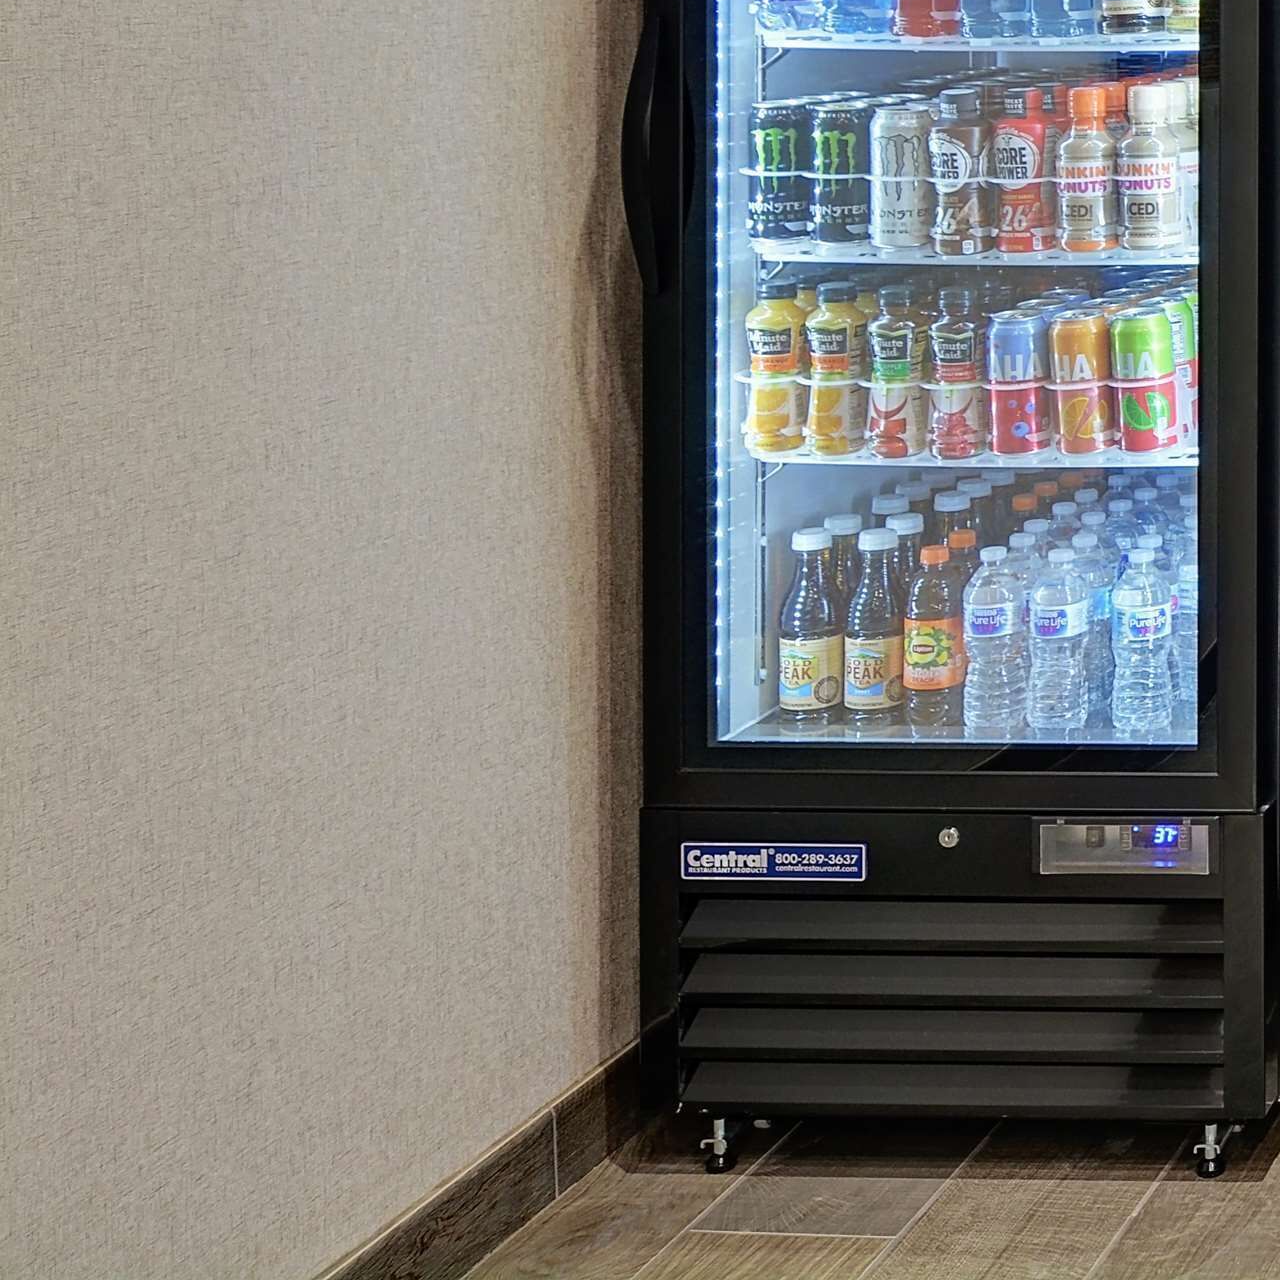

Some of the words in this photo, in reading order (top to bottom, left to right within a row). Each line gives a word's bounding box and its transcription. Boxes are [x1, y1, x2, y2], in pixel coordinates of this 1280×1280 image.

[1058, 165, 1110, 178] UNKIN'
[878, 207, 929, 218] ONSTER
[806, 331, 843, 342] nute
[812, 342, 839, 352] aid
[933, 339, 967, 350] nute
[1054, 353, 1097, 381] HA
[1112, 352, 1156, 379] HA
[971, 616, 989, 625] Pure
[990, 616, 1007, 627] Life
[1036, 617, 1051, 626] ure
[1129, 617, 1150, 628] Pure
[687, 848, 768, 868] Central
[775, 853, 859, 866] 800-289-3637
[775, 864, 858, 873] centralrestaurant.com
